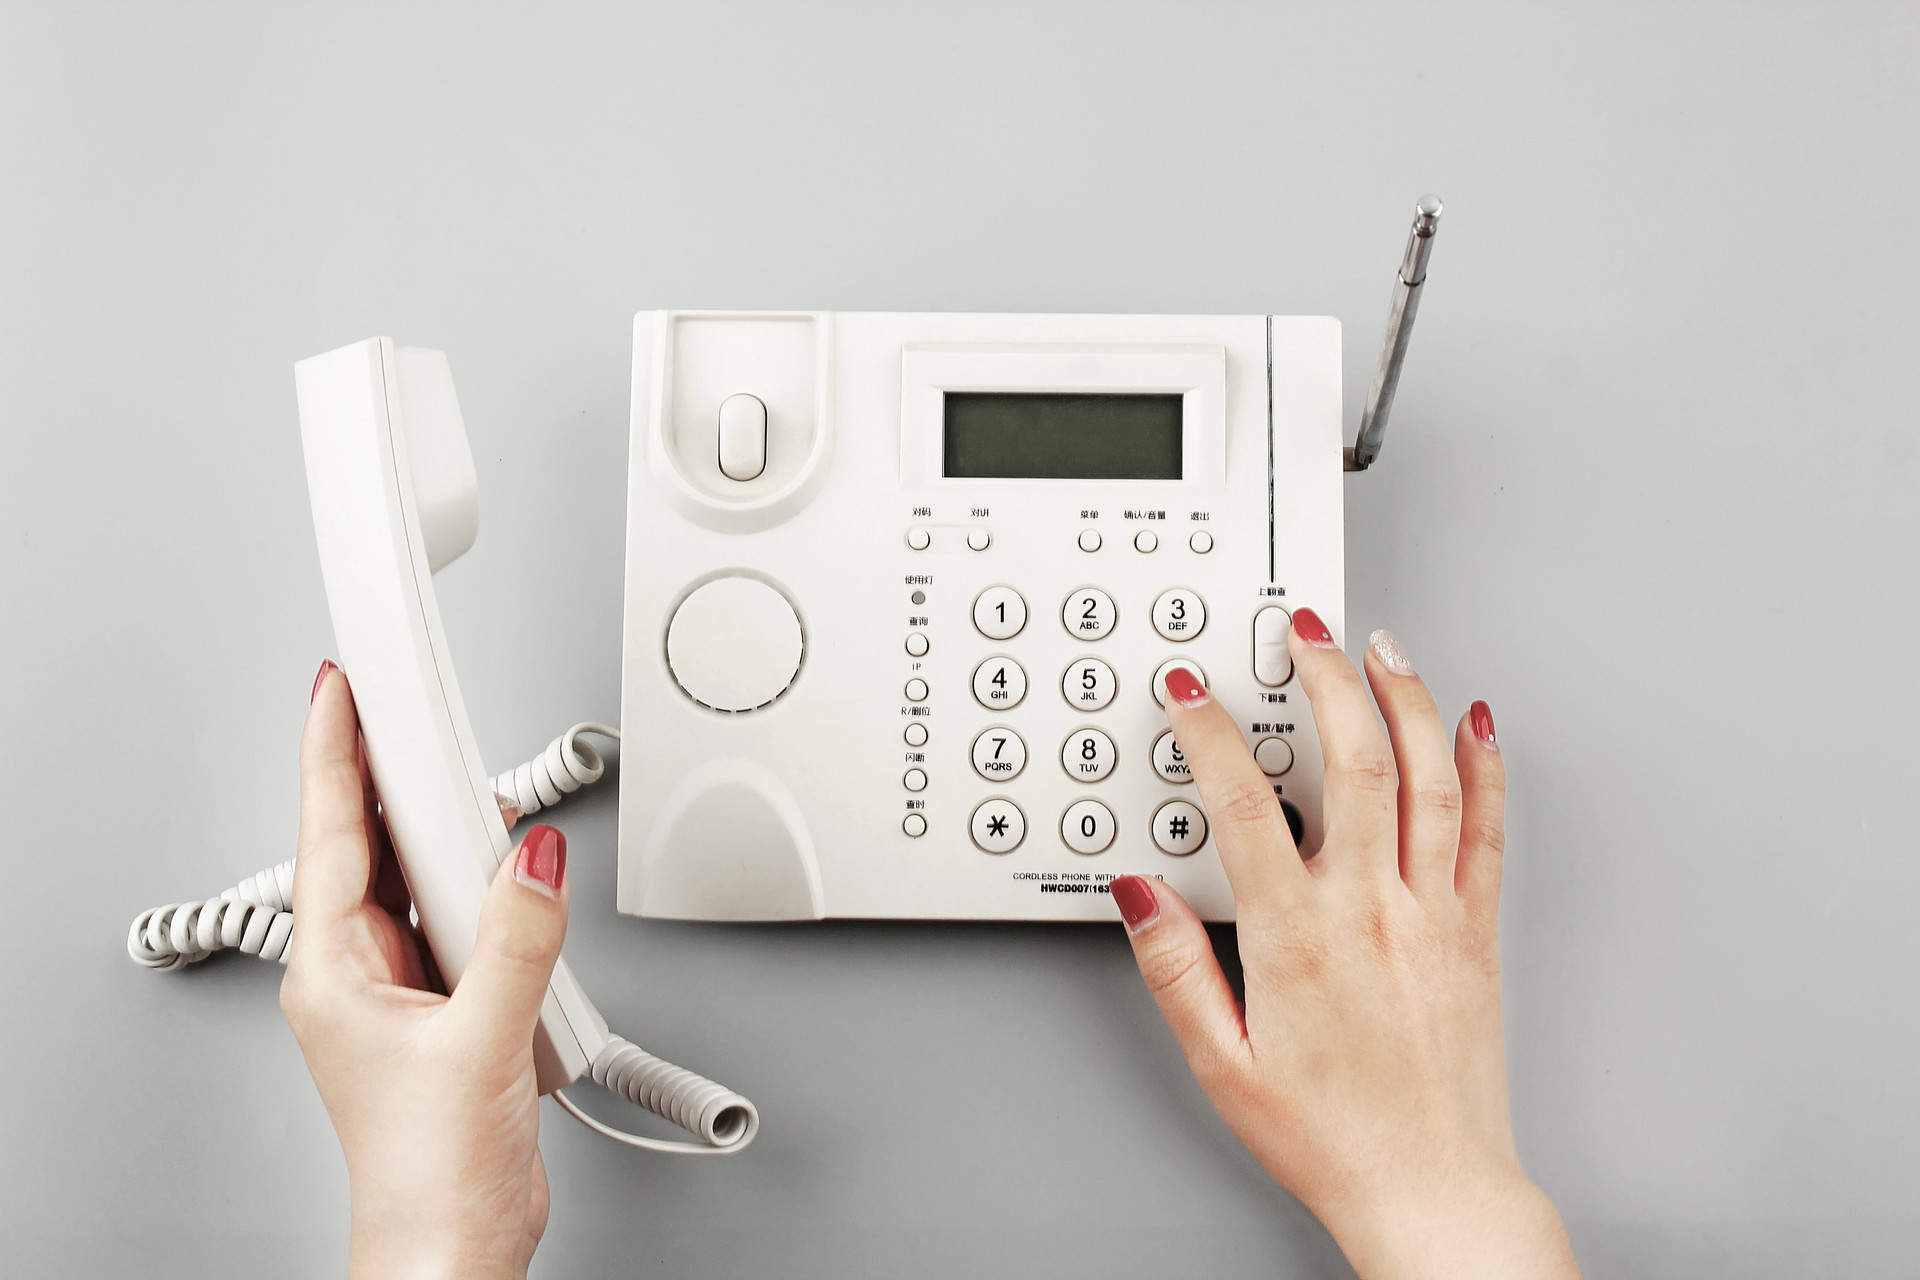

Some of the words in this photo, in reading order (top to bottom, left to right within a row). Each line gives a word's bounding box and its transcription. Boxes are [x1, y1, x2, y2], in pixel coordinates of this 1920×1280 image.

[904, 574, 933, 585] 使用灯
[995, 601, 1005, 623] 1
[1081, 597, 1097, 619] 2
[1170, 598, 1186, 620] 3
[1079, 621, 1100, 631] ABC
[1168, 621, 1188, 631] DEF
[911, 662, 922, 671] IP
[991, 667, 1008, 689] 4
[1081, 668, 1097, 690] 5
[990, 690, 1008, 700] GHI
[1080, 691, 1098, 701] JKL
[991, 737, 1007, 760] 7
[1081, 738, 1097, 761] 8
[984, 761, 1013, 773] PQRS
[1079, 763, 1099, 773] TUV
[1080, 814, 1097, 838] 0
[1012, 872, 1058, 881] CORDLESS
[1062, 873, 1091, 882] PHONE
[1094, 874, 1117, 882] WITH
